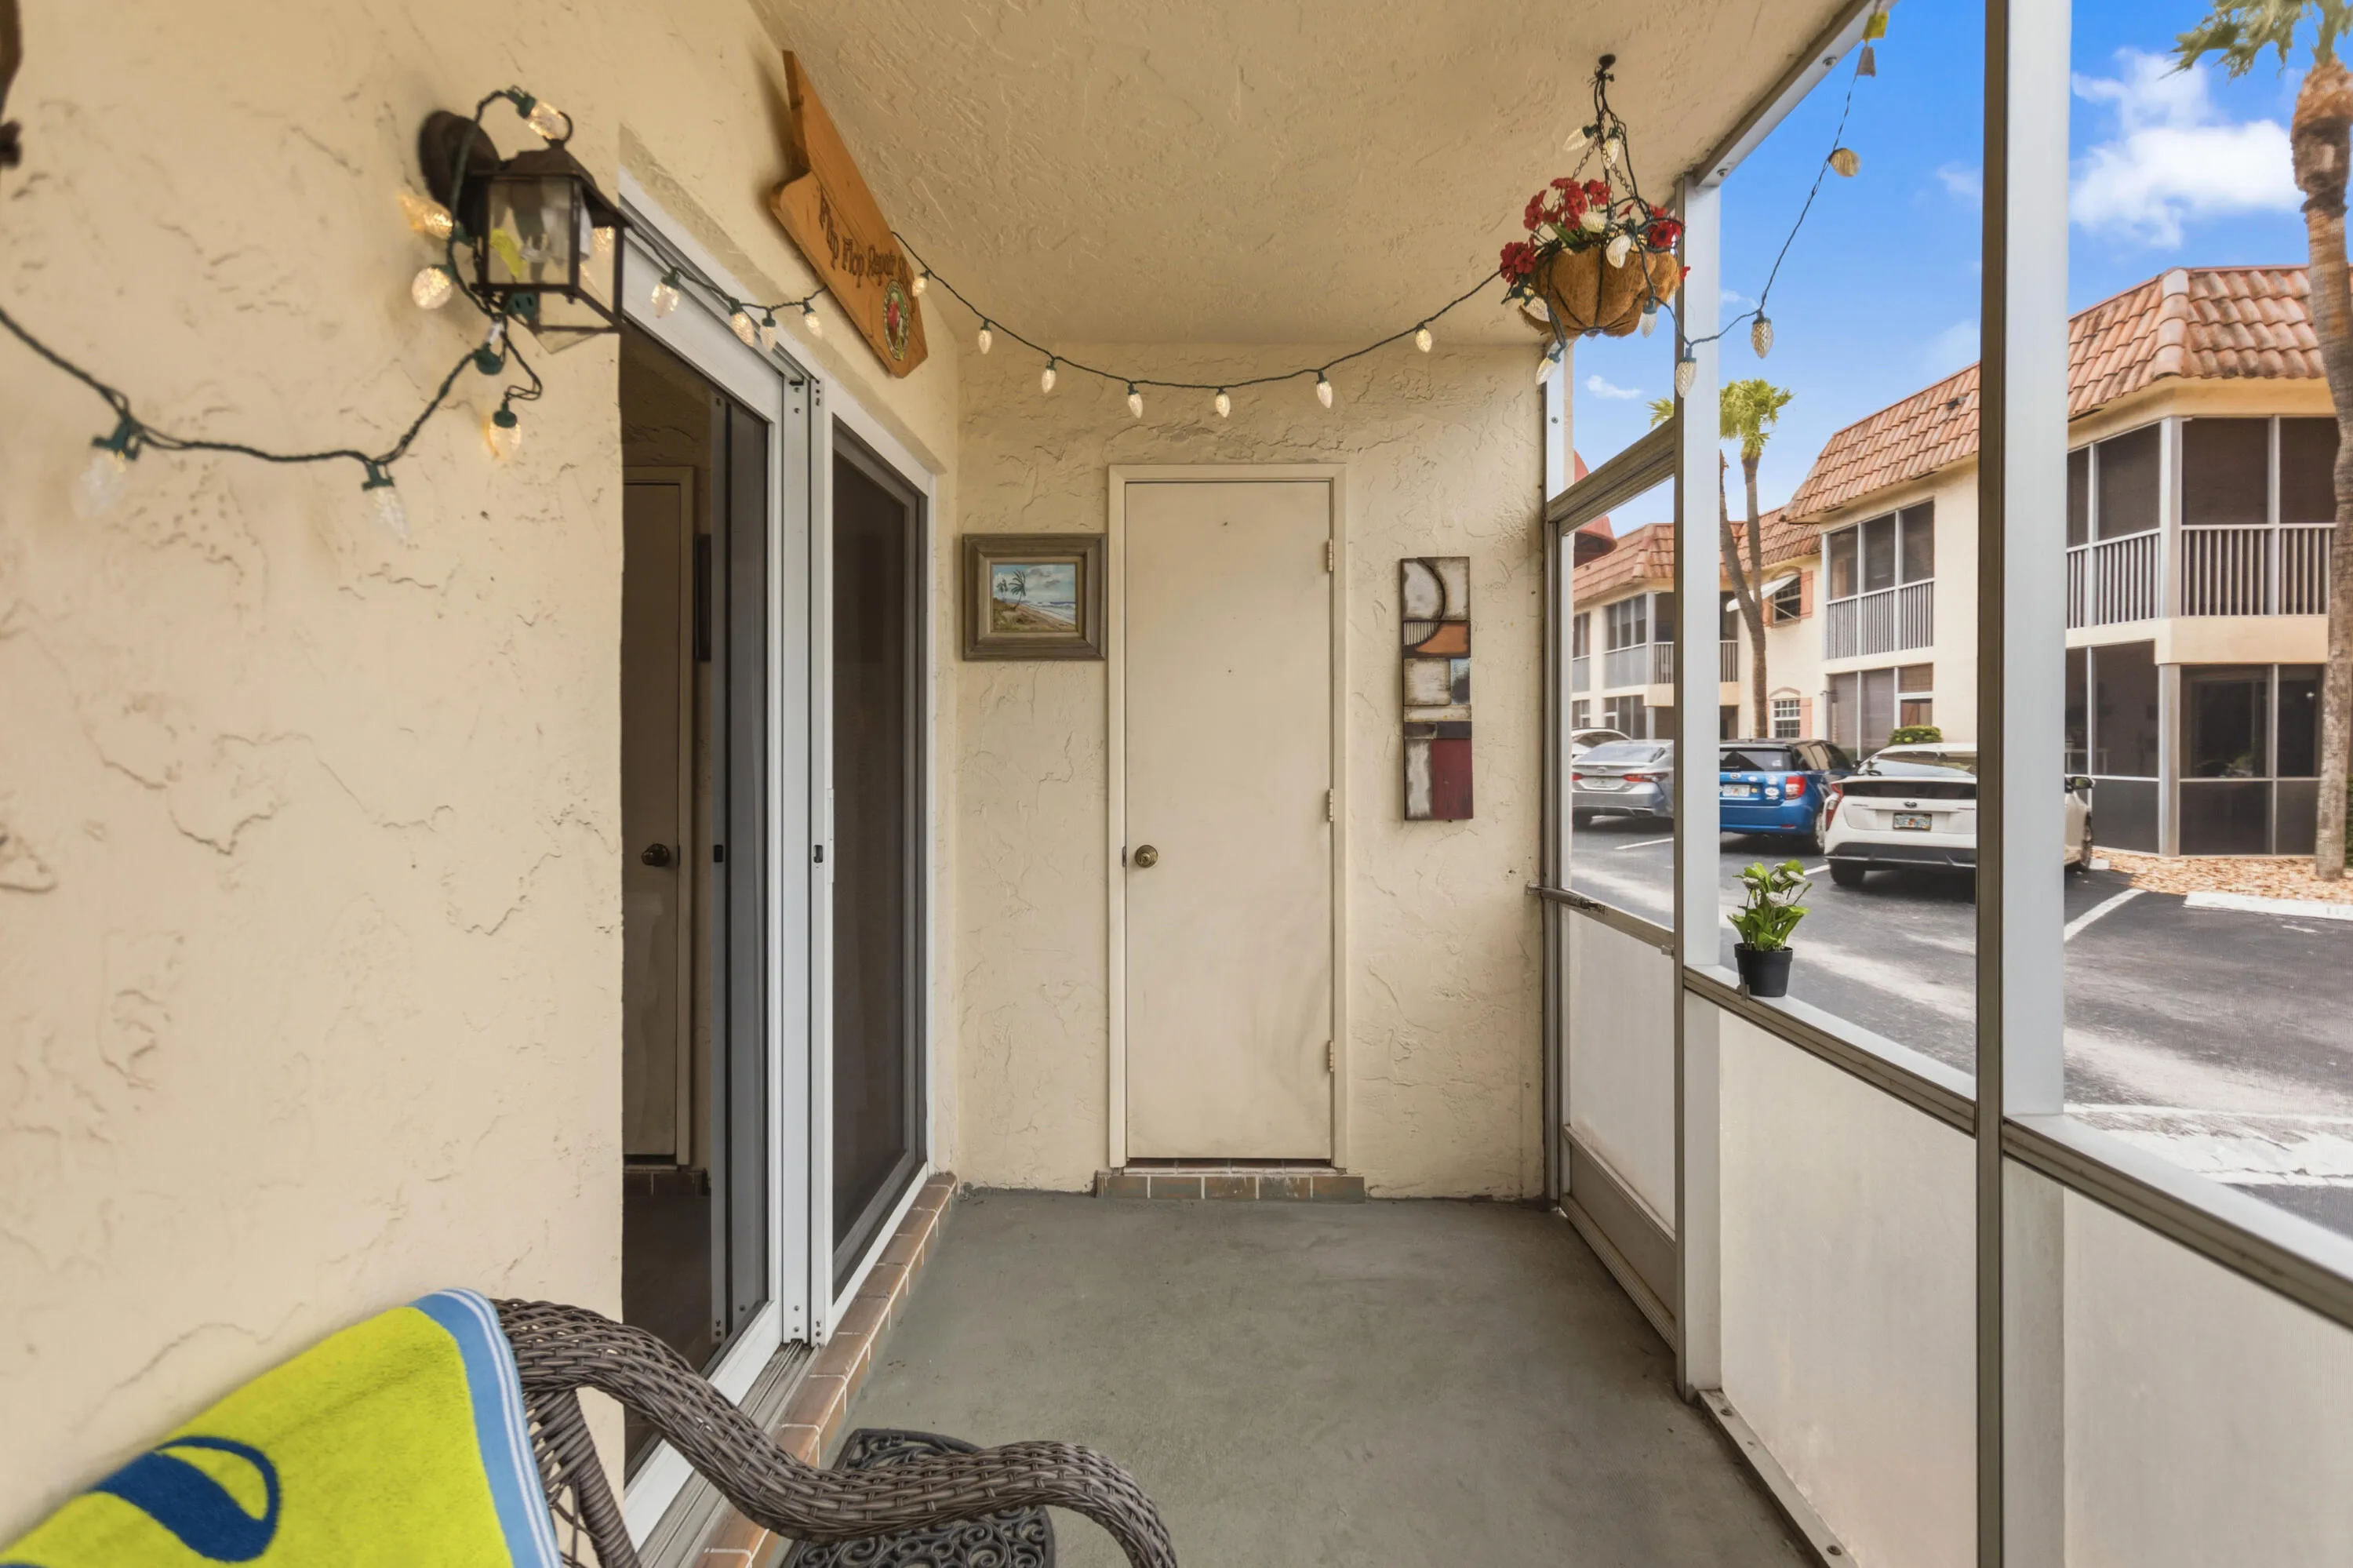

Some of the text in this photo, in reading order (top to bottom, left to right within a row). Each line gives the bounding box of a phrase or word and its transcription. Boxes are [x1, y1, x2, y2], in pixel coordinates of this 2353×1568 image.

[819, 188, 839, 270] Flip
[842, 236, 865, 288] Flop
[867, 245, 896, 286] Repair
